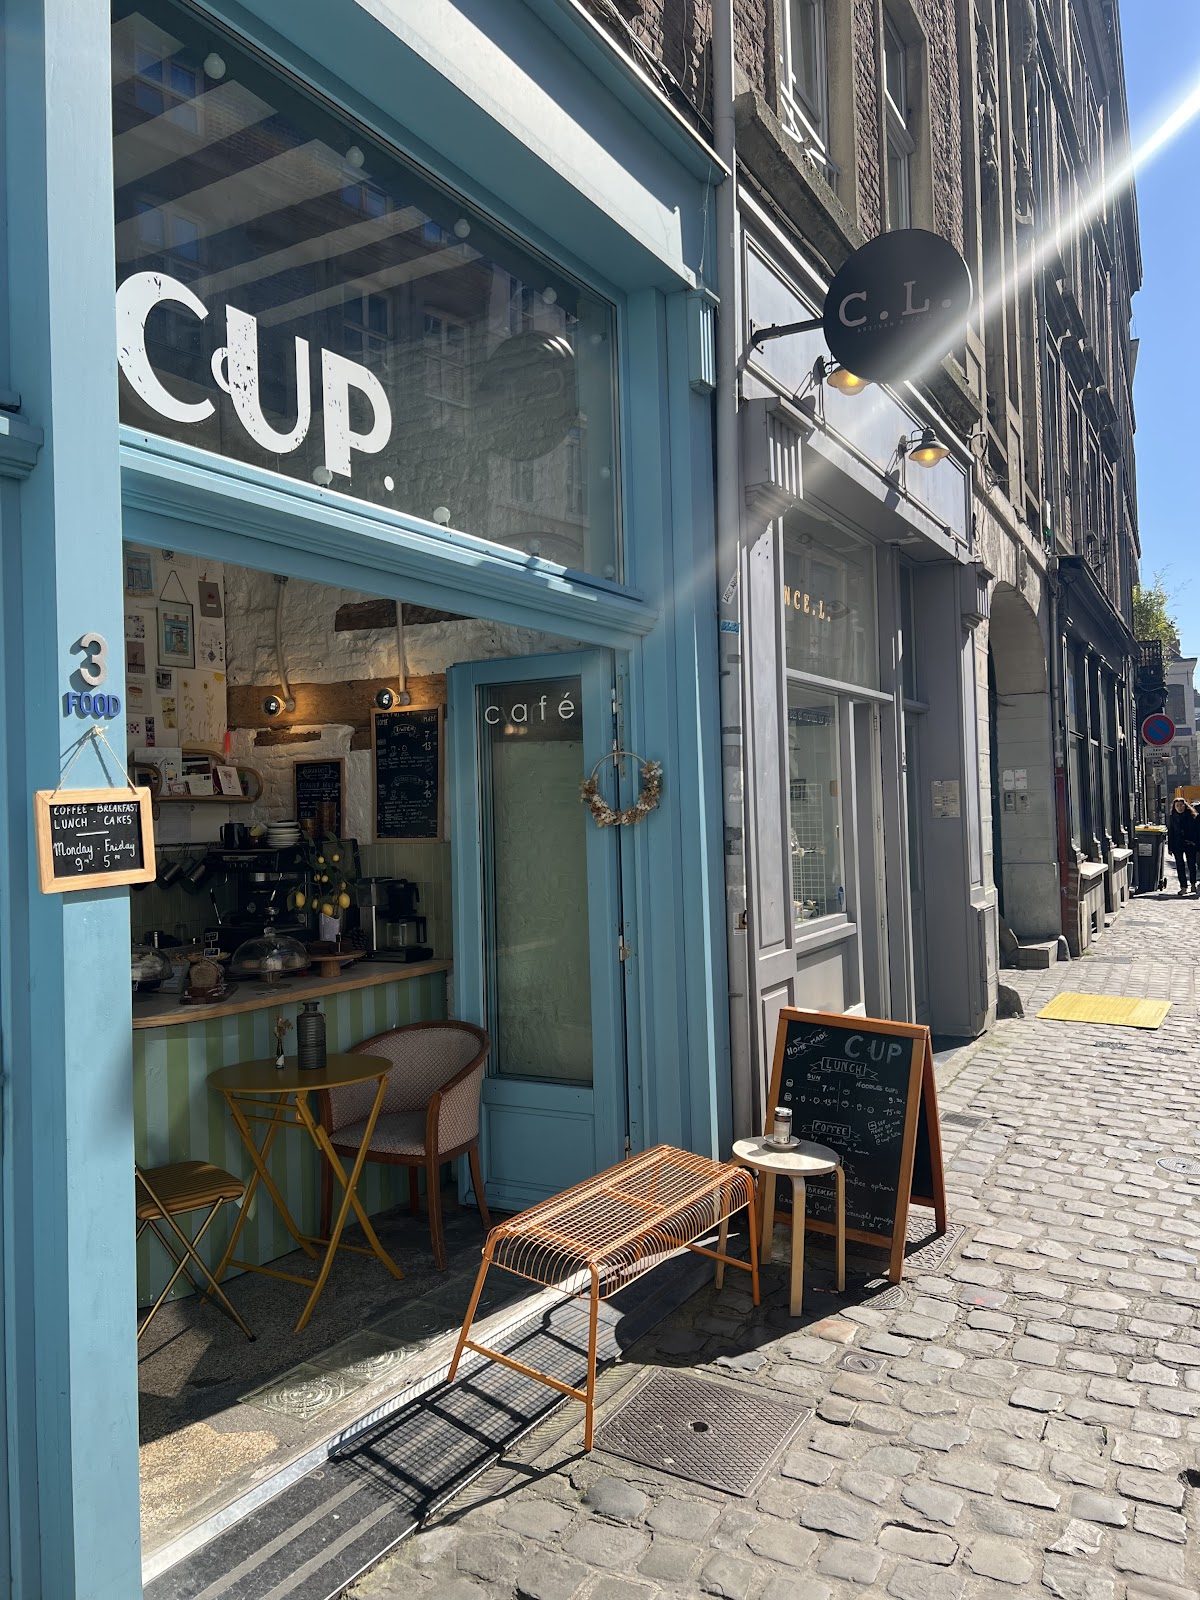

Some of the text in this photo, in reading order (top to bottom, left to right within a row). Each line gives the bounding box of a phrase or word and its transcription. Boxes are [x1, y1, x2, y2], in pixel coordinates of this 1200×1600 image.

[80, 632, 108, 686] 3
[68, 692, 121, 717] FOOD
[484, 692, 575, 724] café
[53, 805, 88, 815] COFFEE
[97, 803, 139, 813] BREAKFAST
[54, 818, 88, 830] LUNCH
[103, 815, 132, 825] CAKES
[53, 842, 93, 860] Monday
[104, 839, 135, 857] Friday
[844, 1035, 902, 1064] CUP
[825, 1060, 864, 1075] LUNCH
[814, 1122, 848, 1136] COFFEE
[815, 1202, 831, 1212] Bowl
